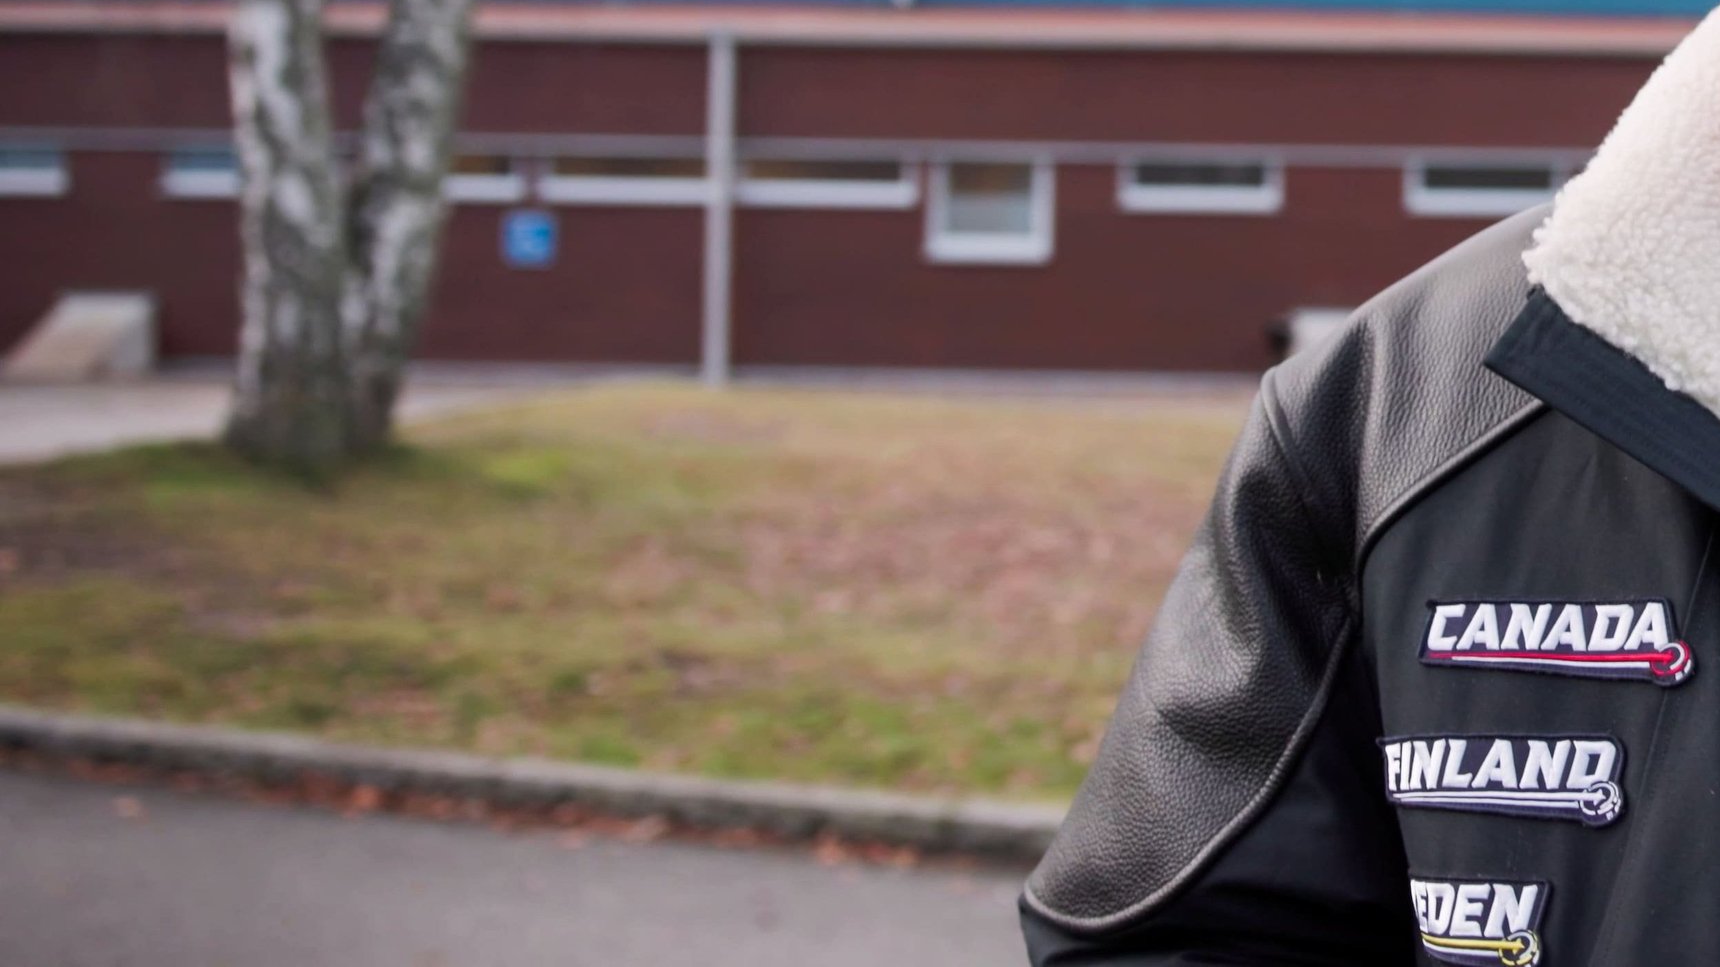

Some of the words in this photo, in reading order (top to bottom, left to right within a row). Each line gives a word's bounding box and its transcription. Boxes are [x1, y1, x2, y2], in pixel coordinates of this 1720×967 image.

[1427, 602, 1669, 652] CANADA
[1385, 738, 1617, 791] FINLAND
[1410, 879, 1539, 938] EDEN
